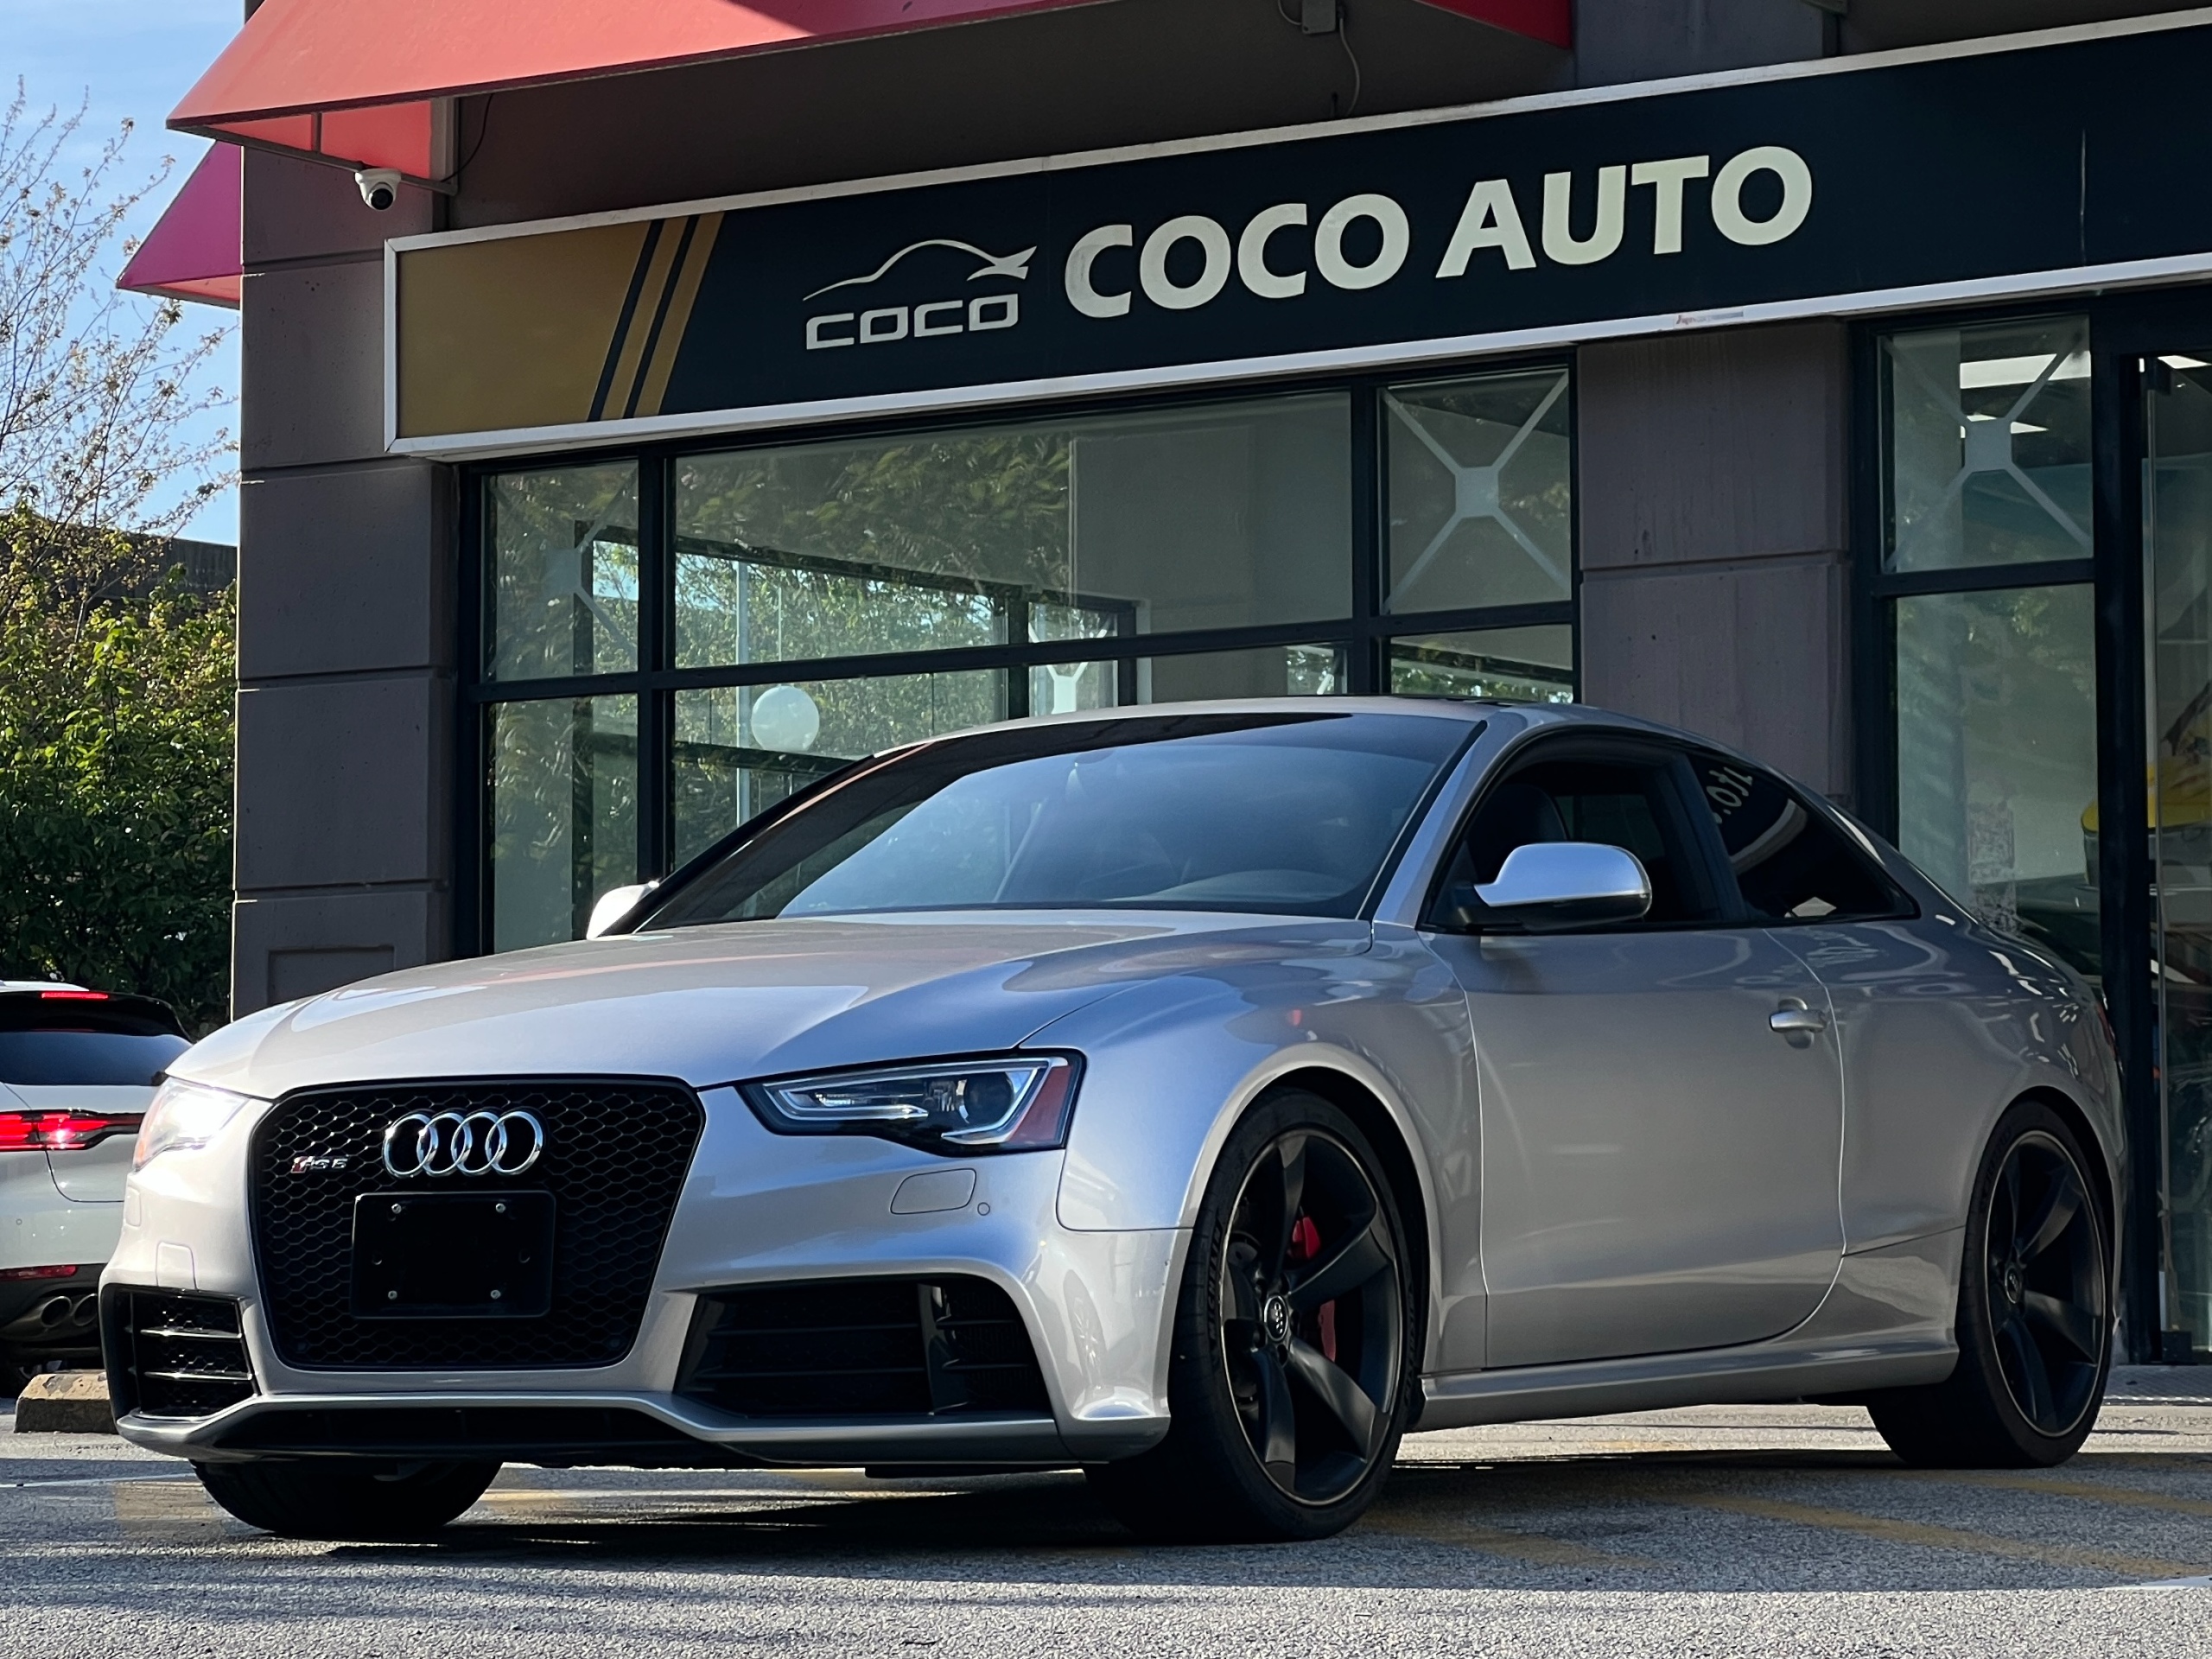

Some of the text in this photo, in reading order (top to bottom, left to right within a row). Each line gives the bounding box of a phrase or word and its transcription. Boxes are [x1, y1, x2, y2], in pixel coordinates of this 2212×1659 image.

[1065, 146, 1812, 318] COCO AUTO
[806, 294, 1018, 349] COCO
